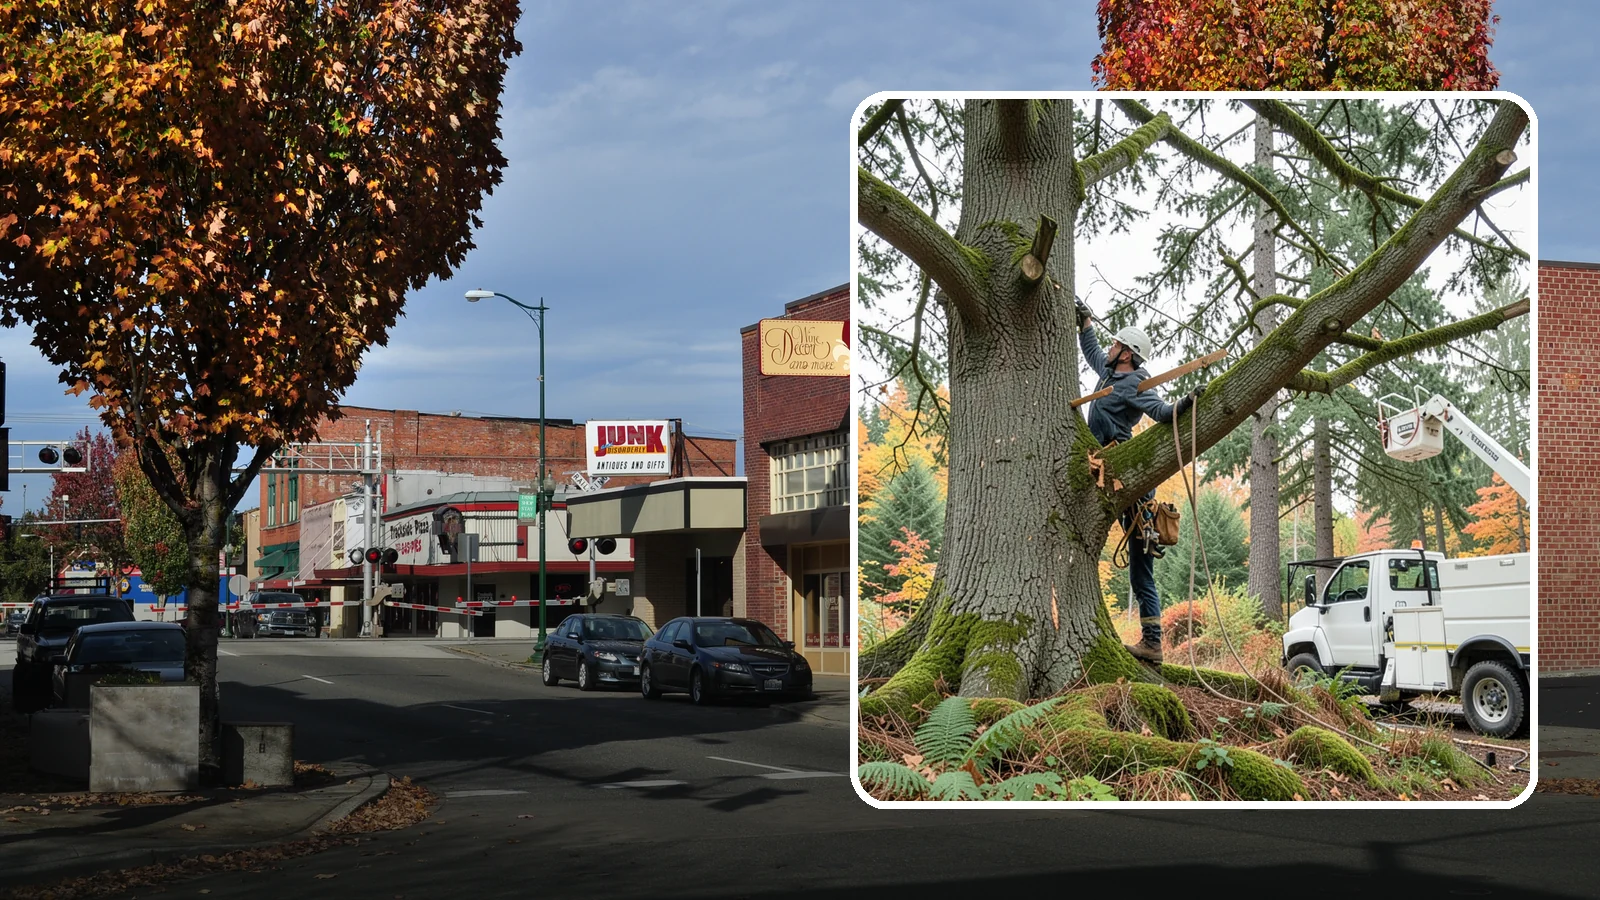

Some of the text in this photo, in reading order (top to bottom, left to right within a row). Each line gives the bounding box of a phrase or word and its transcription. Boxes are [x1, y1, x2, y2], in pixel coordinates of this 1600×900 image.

[595, 425, 665, 457] JUNK
[607, 446, 646, 454] DISORDERLY
[596, 460, 665, 470] ANTIQUES AND GIFTS
[414, 520, 429, 536] Pizza
